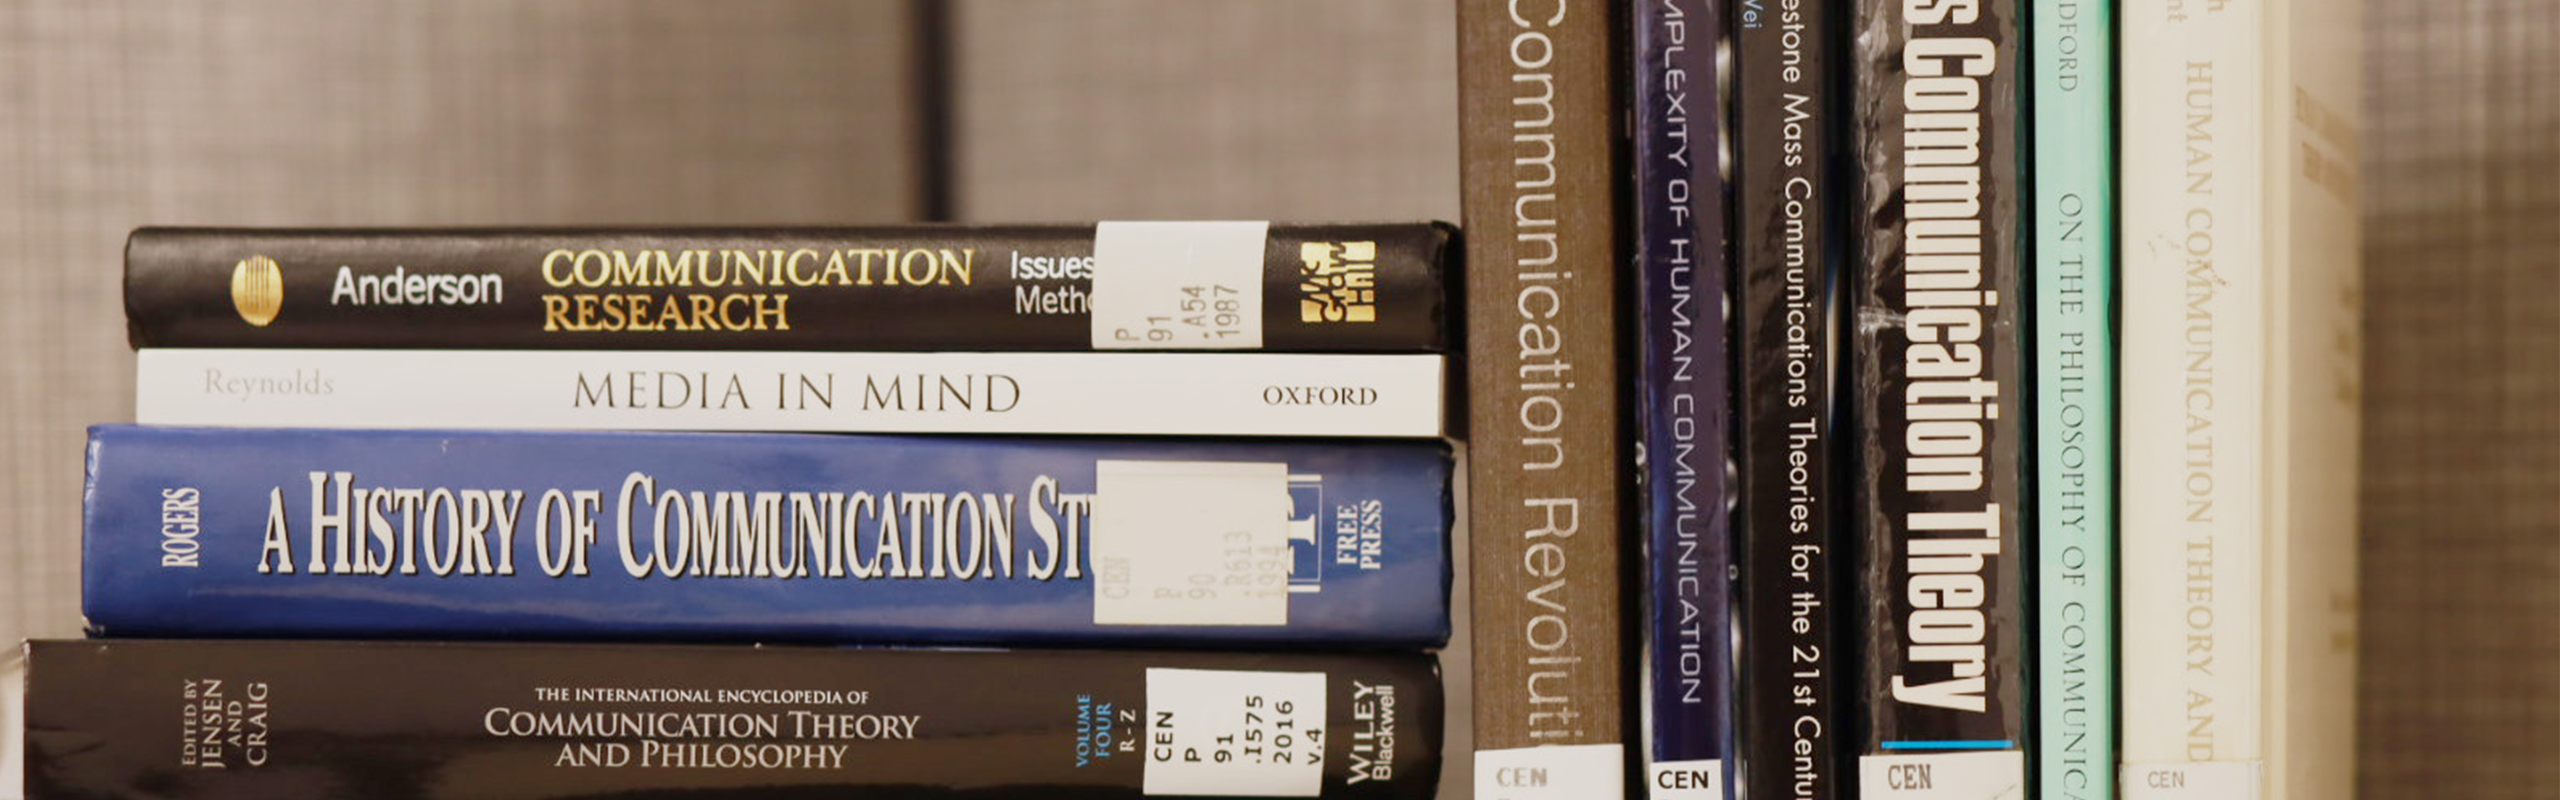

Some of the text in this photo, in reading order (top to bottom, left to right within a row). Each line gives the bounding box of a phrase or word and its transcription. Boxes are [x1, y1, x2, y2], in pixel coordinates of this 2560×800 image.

[2059, 0, 2077, 92] DFORD
[1784, 93, 1810, 167] Mass
[1669, 180, 1690, 227] OF
[2059, 193, 2083, 243] ON
[331, 266, 503, 306] Anderson
[541, 247, 974, 287] COMMUNICATION
[1903, 38, 1999, 492] Communication
[2060, 254, 2083, 315] THE
[542, 293, 790, 332] RESEARCH
[1181, 285, 1209, 339] .A54
[1214, 285, 1241, 338] 1987
[1670, 239, 1692, 381] HUMAN
[1785, 177, 1815, 408] Communications
[1115, 328, 1140, 341] P
[1147, 316, 1173, 342] 91
[204, 368, 334, 401] Reynolds
[573, 371, 1020, 413] MEDIA IN MIND
[1262, 385, 1378, 406] OXFORD
[1508, 0, 1584, 738] Communication Revoluti
[2060, 331, 2085, 532] PHILOSOPHY
[2186, 60, 2214, 762] HUMAN COMMUNICATION THEORY AND
[1789, 418, 1817, 533] Theories
[161, 487, 200, 567] ROGERS
[258, 485, 294, 574] A
[536, 489, 599, 577] OF
[1336, 504, 1358, 564] FREE
[1359, 499, 1382, 569] PRESS
[1673, 393, 1701, 703] COMMUNICATION
[1791, 545, 1820, 583] for
[2062, 545, 2085, 587] OF
[1792, 591, 1820, 634] the
[1892, 503, 2000, 713] Theory
[536, 687, 869, 705] THE INTERNATIONAL ENCYCLOPEDIA OF
[1793, 644, 1820, 705] 21st
[182, 678, 197, 766] EDITED BY
[201, 679, 226, 768] JENSEN
[227, 700, 243, 747] AND
[247, 682, 268, 767] CRAIG
[1076, 693, 1091, 768] VOLUME
[1095, 703, 1112, 758] FOUR
[1154, 711, 1174, 763] CEN
[1214, 733, 1234, 763] 91
[1244, 695, 1264, 764] .I575
[1274, 700, 1293, 764] 2016
[1306, 728, 1323, 765] v.4
[1347, 680, 1374, 785] WILEY
[1373, 685, 1395, 781] Blackwell
[554, 743, 630, 767] AND
[1184, 747, 1202, 763] P
[1496, 767, 1548, 788] CEN
[1658, 770, 1709, 789] CEN
[1888, 764, 1932, 790] CEN
[2147, 771, 2185, 789] CEN
